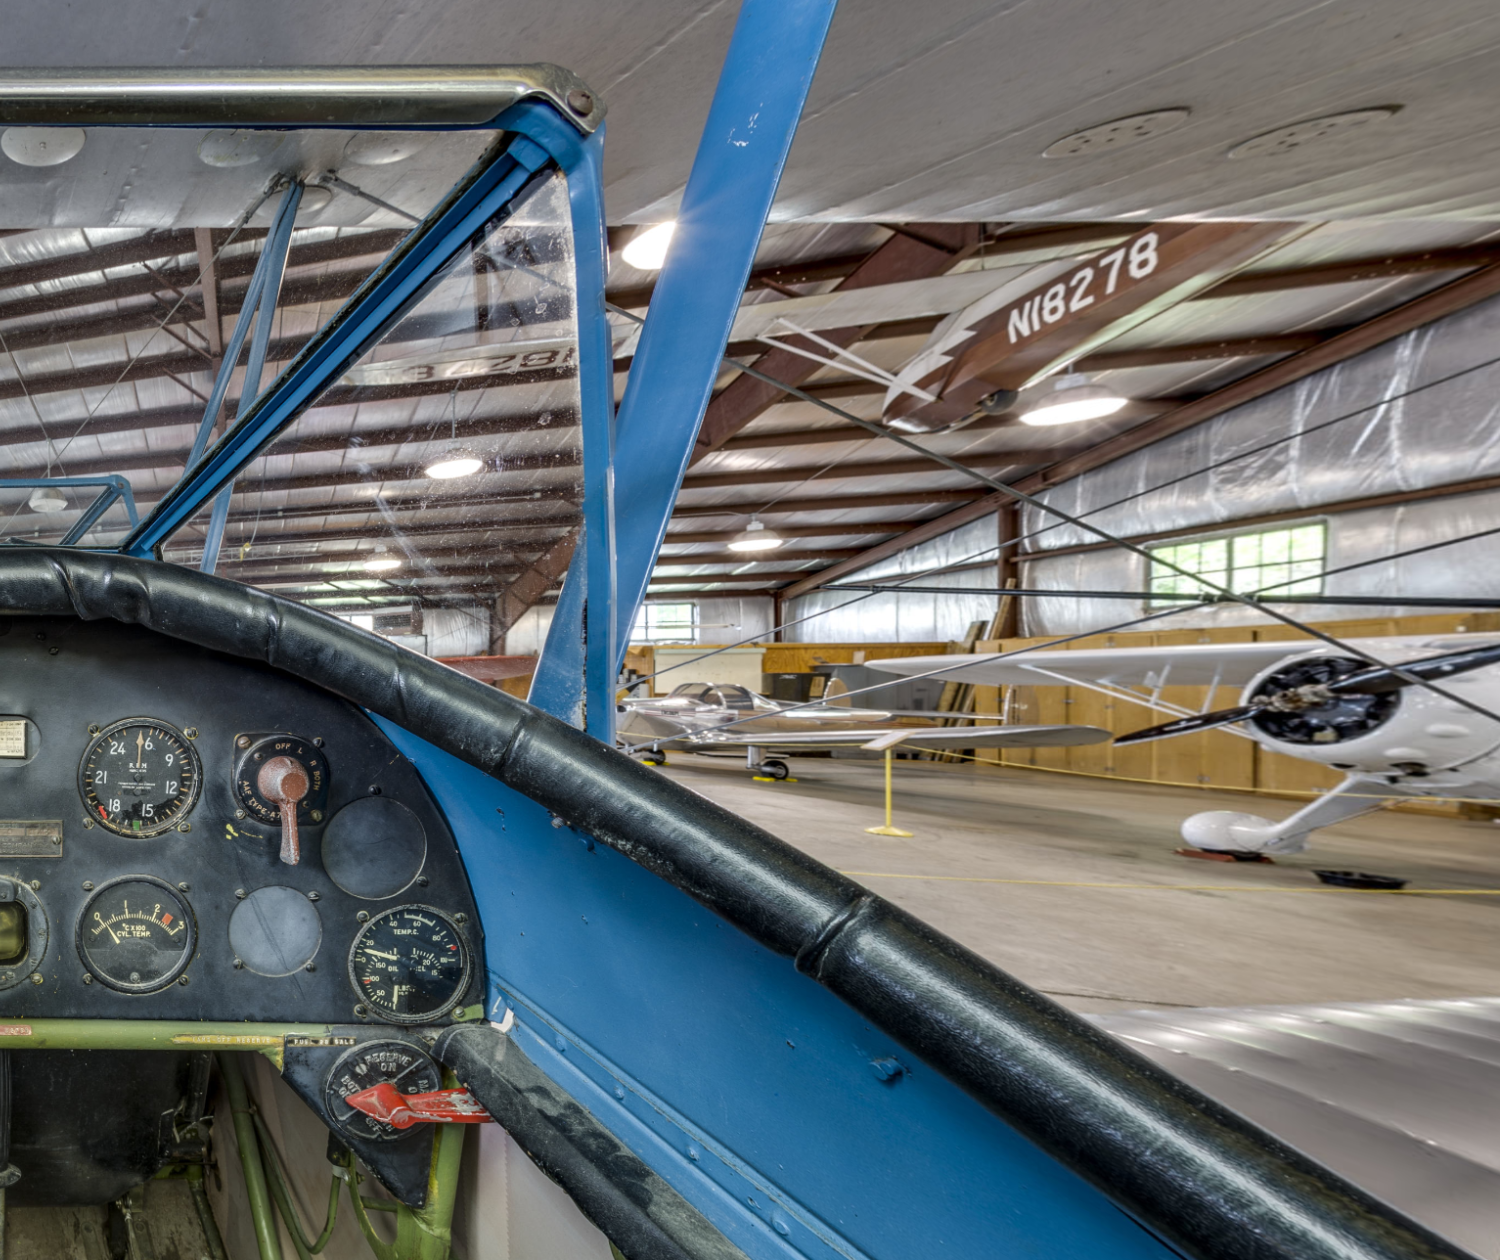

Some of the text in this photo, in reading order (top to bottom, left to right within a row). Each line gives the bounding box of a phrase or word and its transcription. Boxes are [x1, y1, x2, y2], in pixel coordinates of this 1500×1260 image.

[1007, 232, 1159, 344] N18278
[110, 741, 126, 755] 24
[145, 737, 153, 750] 6
[275, 742, 292, 750] OFF
[165, 753, 174, 767] 9
[95, 770, 107, 784] 21
[313, 770, 321, 791] BOTH
[165, 780, 178, 795] 12
[109, 798, 121, 812] 18
[141, 803, 154, 817] 15
[154, 903, 161, 912] 2
[93, 912, 100, 921] 0
[178, 920, 185, 929] 3
[364, 1051, 412, 1067] RESERVE
[380, 1062, 397, 1072] ON
